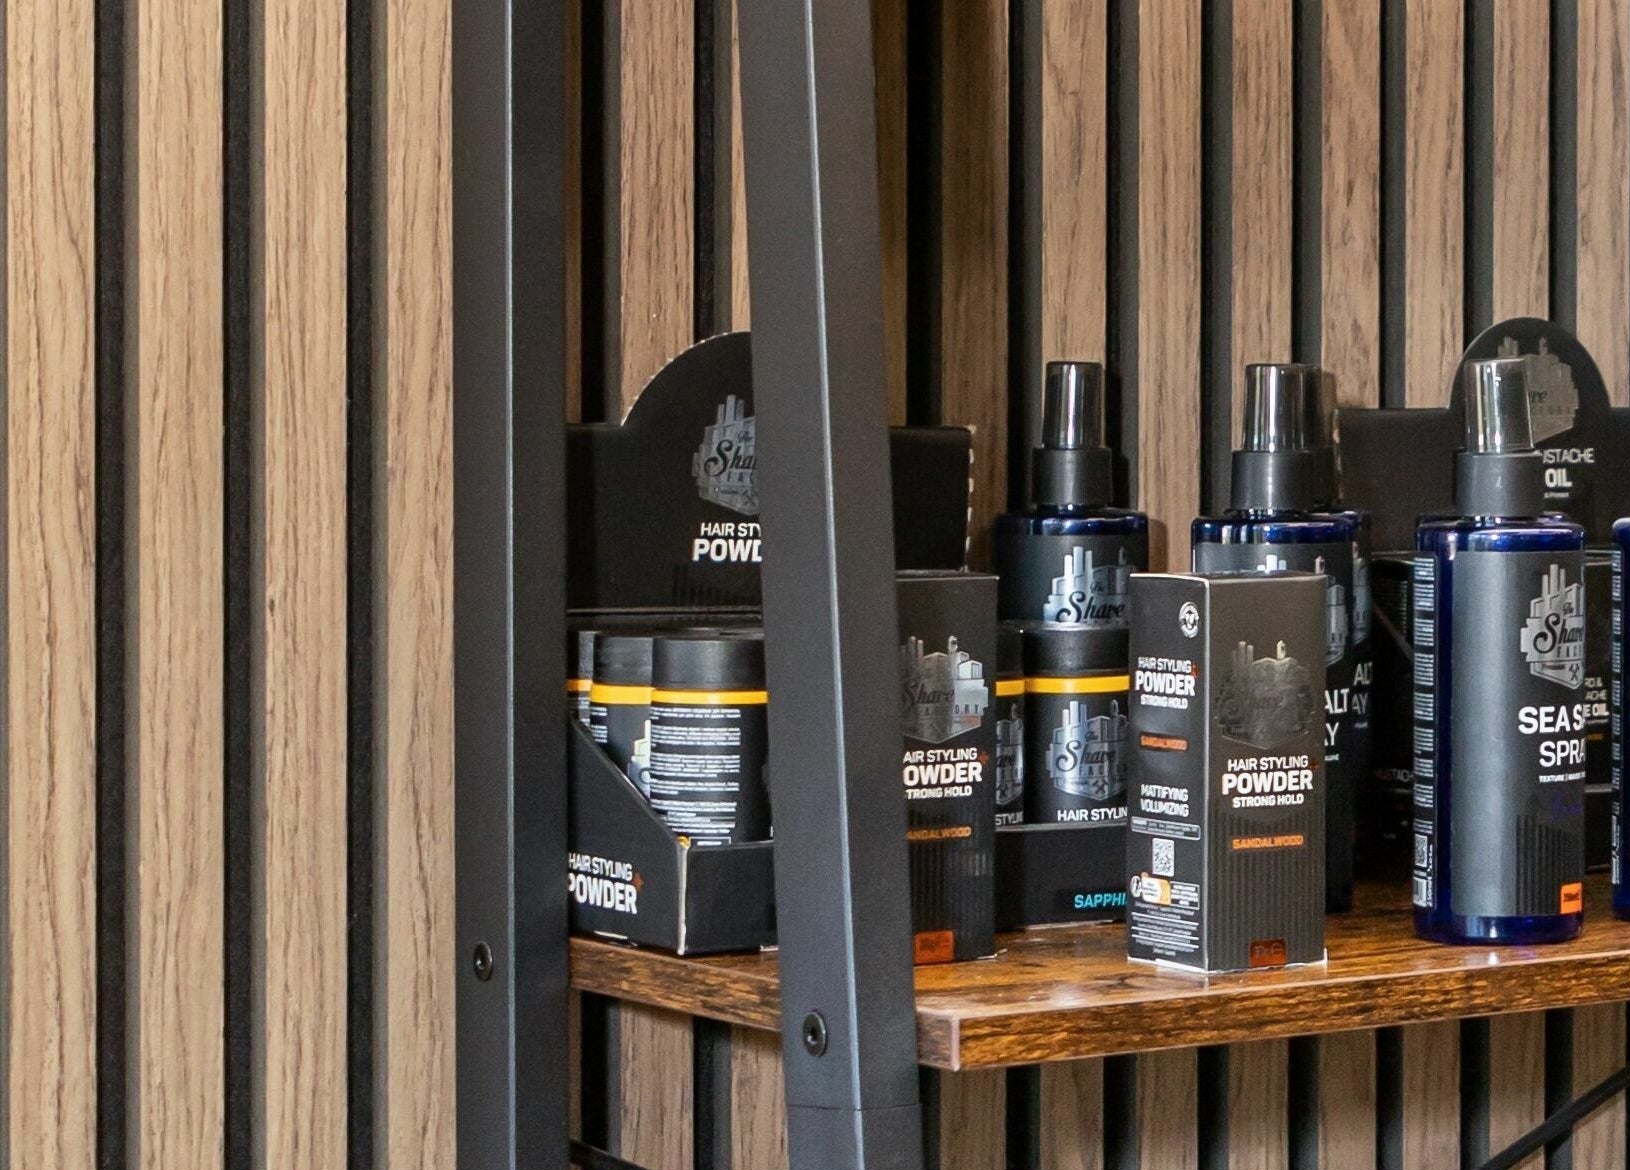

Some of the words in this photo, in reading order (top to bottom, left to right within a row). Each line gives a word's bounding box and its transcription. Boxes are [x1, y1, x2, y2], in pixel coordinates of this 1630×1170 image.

[1545, 468, 1573, 488] OIL
[700, 522, 735, 537] HAIR
[1138, 657, 1156, 670] HAIR
[1157, 658, 1192, 673] STYLING
[1135, 671, 1195, 697] POWDER
[1518, 705, 1571, 734] SEA
[926, 747, 978, 763] STYLING
[1228, 758, 1258, 771] HAIR
[1259, 755, 1308, 770] STYLING
[1222, 769, 1313, 795] POWDER
[944, 785, 973, 798] HOLD
[1232, 795, 1276, 808] STRONG
[1277, 793, 1304, 805] HOLD
[1057, 809, 1089, 822] HAIR
[569, 852, 591, 872] HAIR
[592, 856, 632, 881] STYLING
